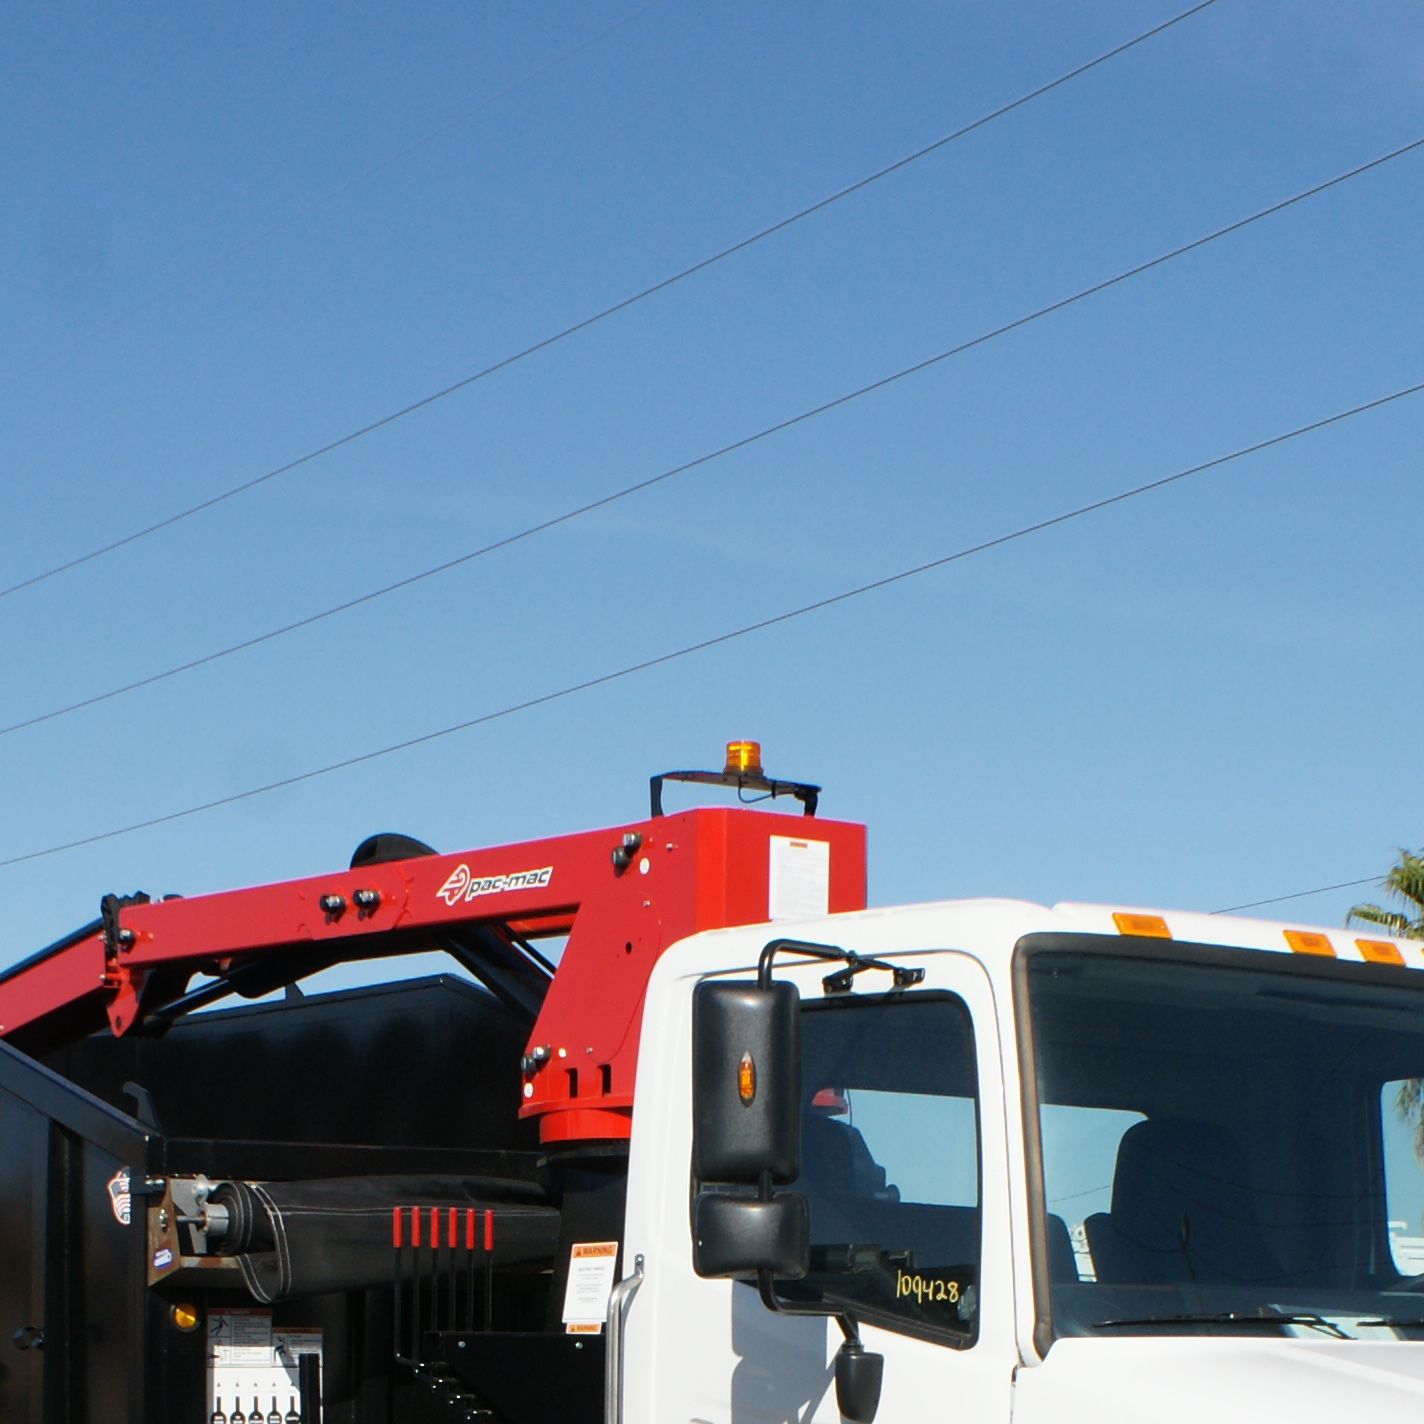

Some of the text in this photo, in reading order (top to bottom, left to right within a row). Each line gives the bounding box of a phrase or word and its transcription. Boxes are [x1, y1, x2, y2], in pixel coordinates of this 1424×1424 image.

[467, 868, 551, 899] pac-mac
[583, 1246, 613, 1257] WARNING
[896, 1269, 959, 1304] 109428
